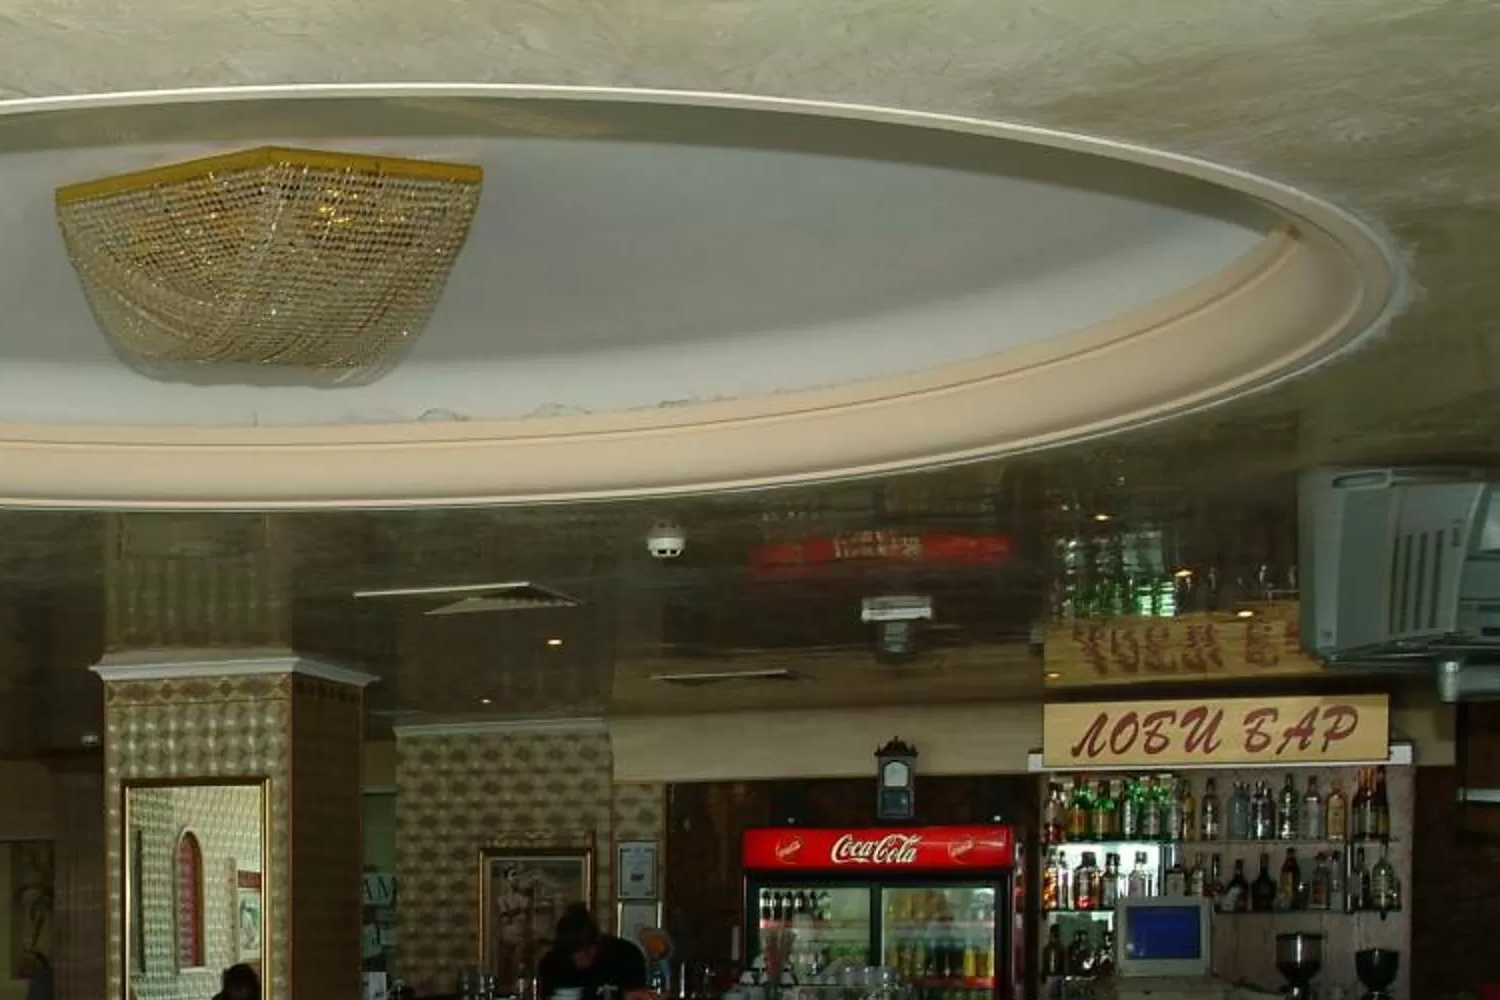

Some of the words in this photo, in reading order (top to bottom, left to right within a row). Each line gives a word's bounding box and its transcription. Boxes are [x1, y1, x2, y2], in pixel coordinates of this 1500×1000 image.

[1071, 705, 1224, 758] ЛОБИ
[1242, 705, 1359, 754] БАР
[831, 834, 921, 864] Coca-Cola
